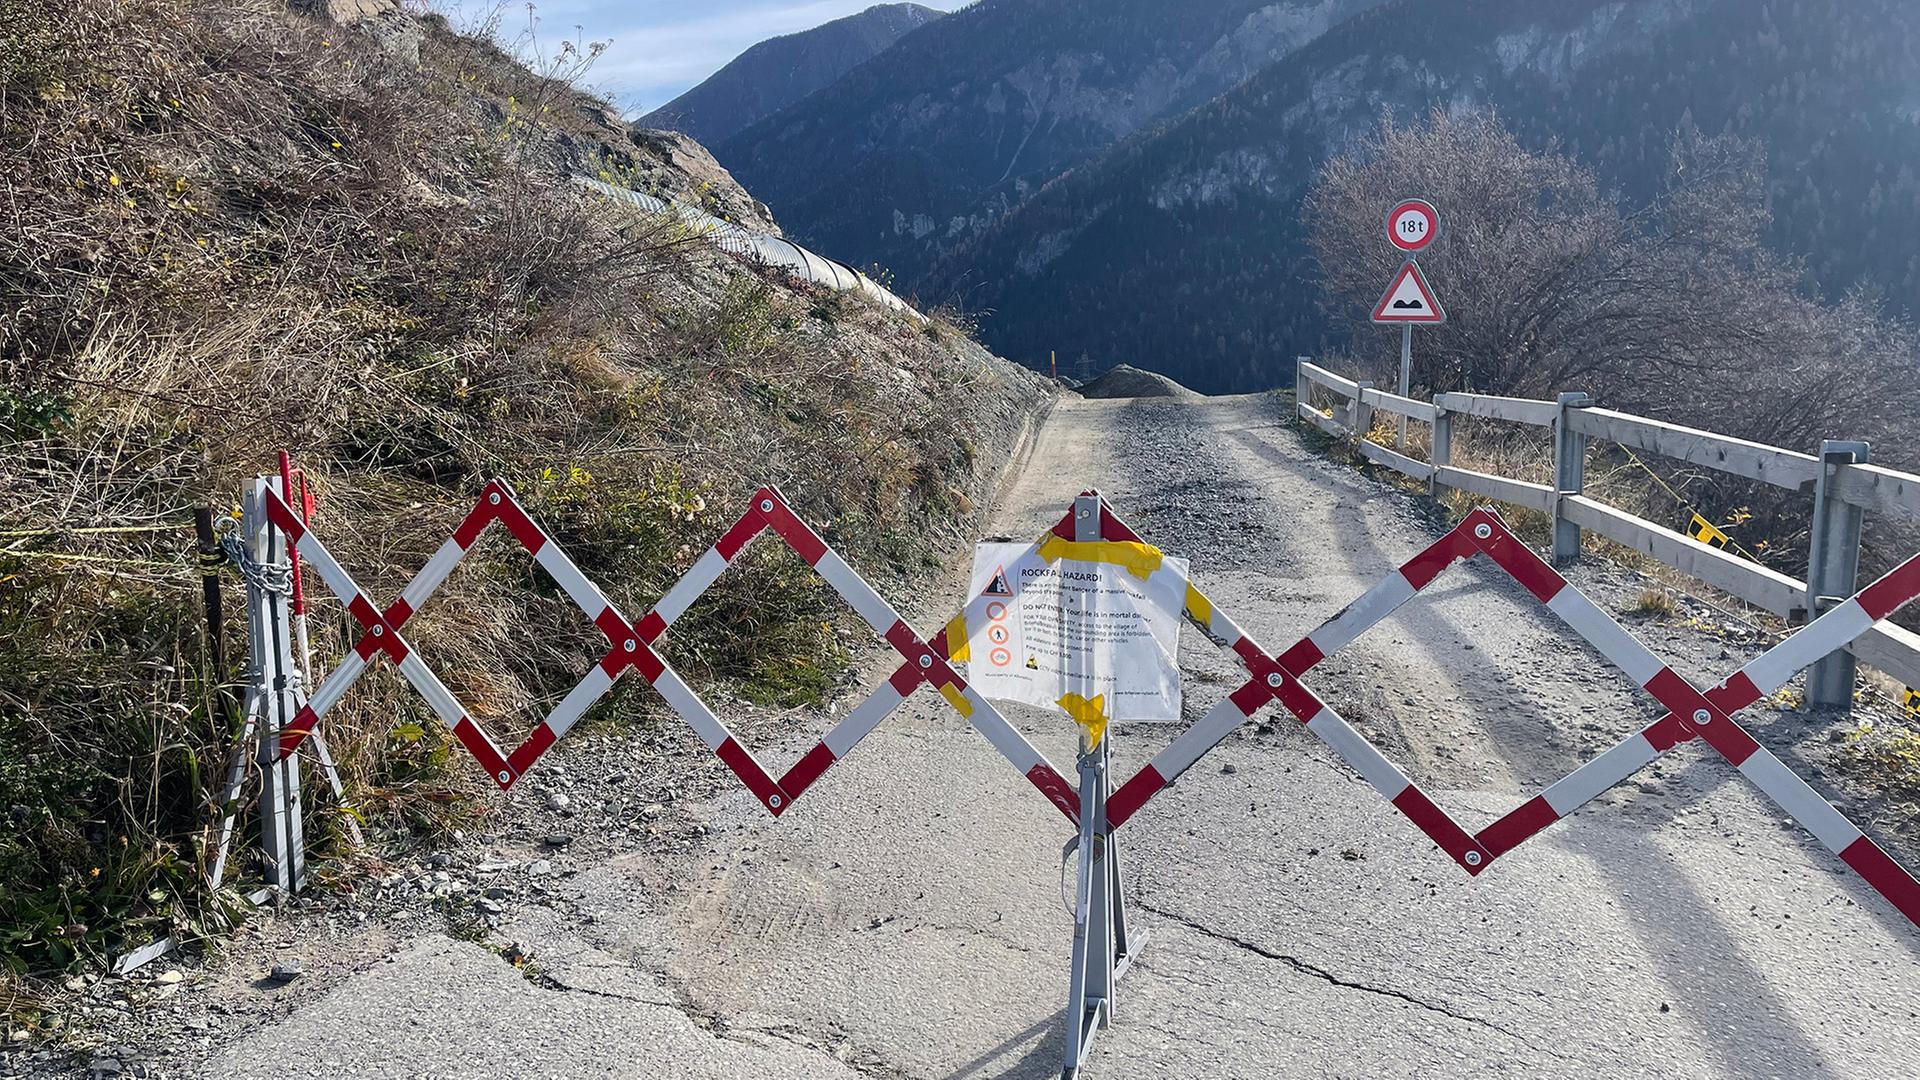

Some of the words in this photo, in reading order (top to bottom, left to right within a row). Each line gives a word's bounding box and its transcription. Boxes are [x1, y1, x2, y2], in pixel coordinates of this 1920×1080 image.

[1401, 220, 1416, 233] 18
[1418, 222, 1424, 232] t
[1063, 570, 1102, 582] HAZARD!
[1066, 607, 1080, 616] Your
[1094, 610, 1100, 618] is
[1109, 611, 1131, 619] mortal
